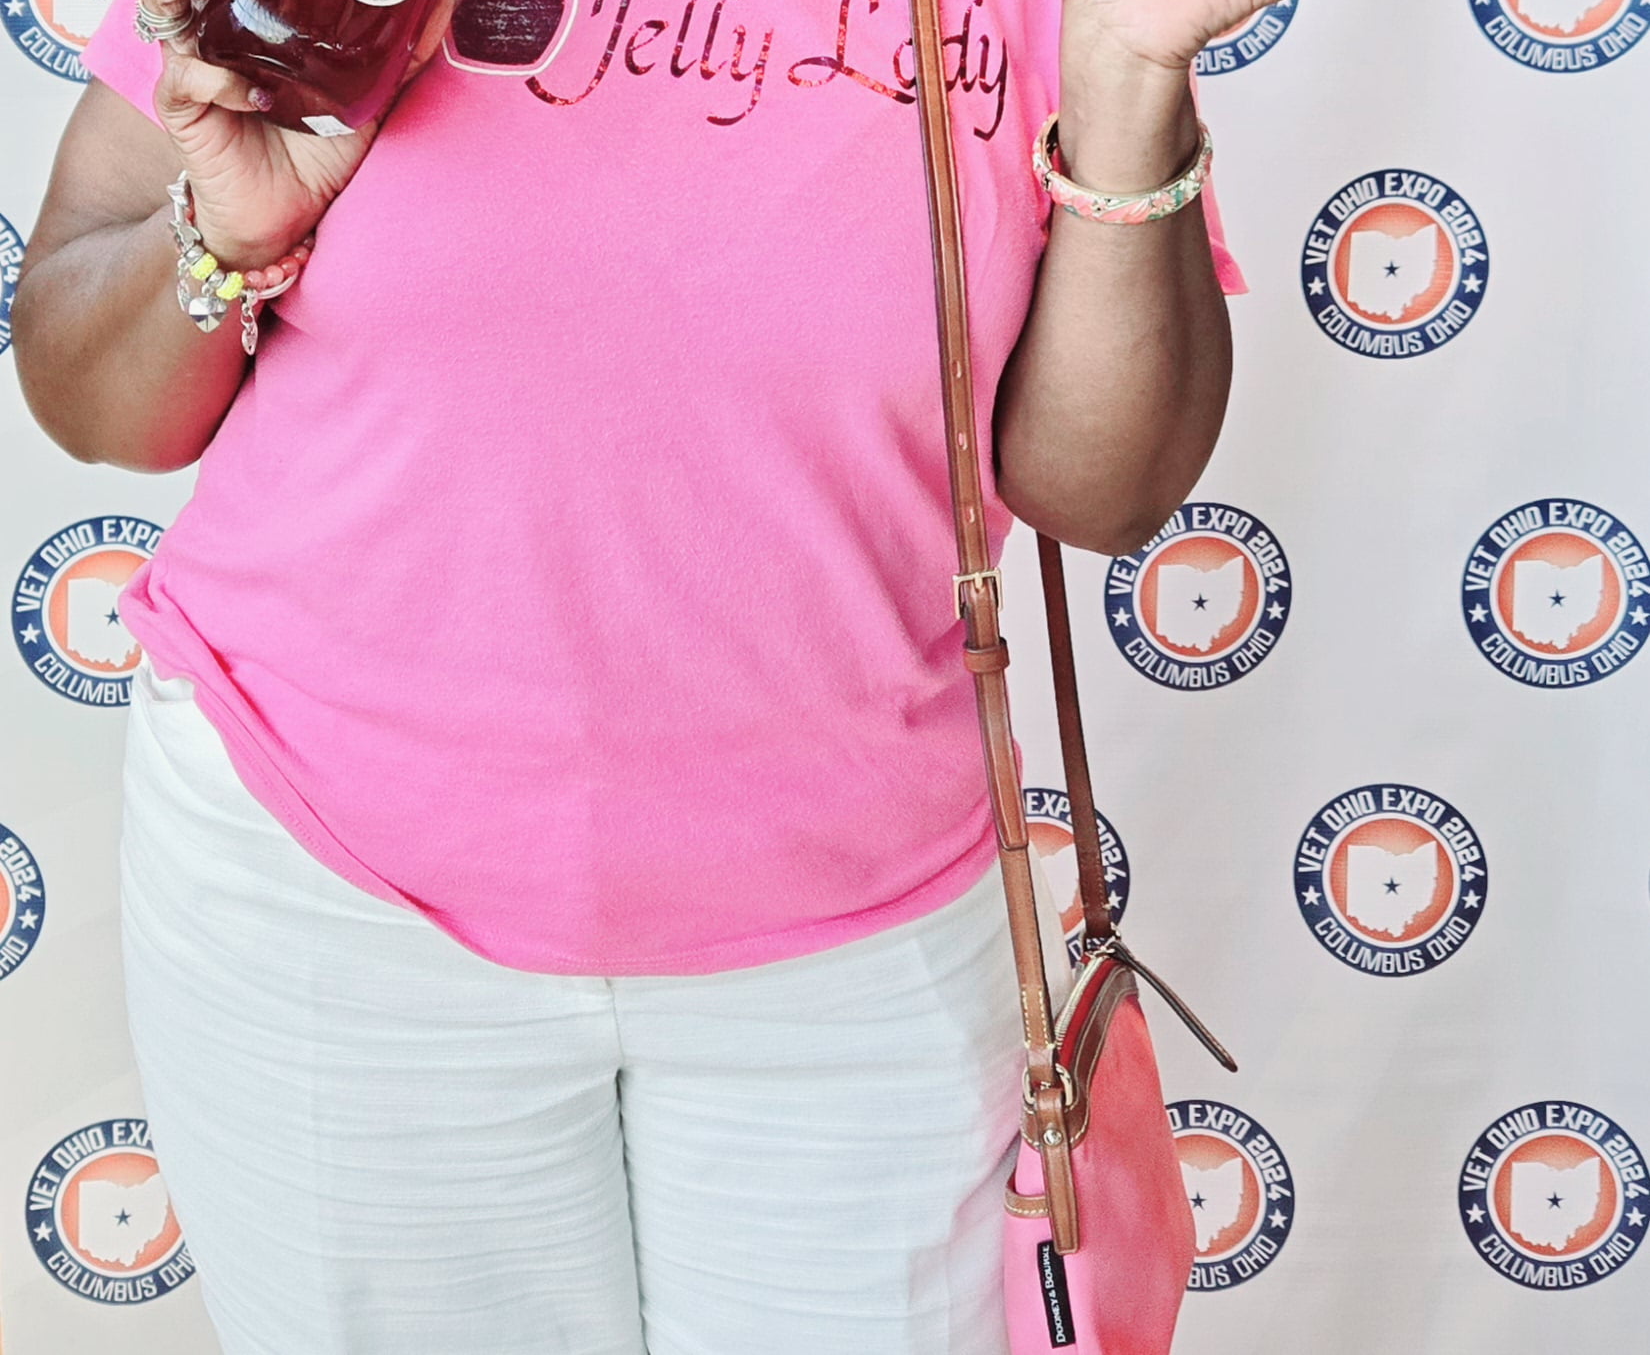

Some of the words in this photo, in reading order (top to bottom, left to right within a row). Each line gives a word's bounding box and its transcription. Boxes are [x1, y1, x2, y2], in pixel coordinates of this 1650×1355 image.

[19, 26, 92, 81] COLUM
[1237, 15, 1284, 60] OHIO
[1484, 15, 1598, 69] COLUMBUS
[1599, 14, 1649, 58] OHIO
[1305, 219, 1336, 265] VET
[1328, 177, 1379, 221] OHIO
[1384, 173, 1447, 207] EXPO
[1440, 200, 1486, 266] 2024
[1318, 304, 1424, 355] COLUMBUS
[1425, 300, 1472, 344] OHIO
[16, 565, 49, 613] VET
[40, 524, 96, 568] OHIO
[1108, 555, 1140, 595] VET
[1192, 507, 1252, 539] EXPO
[1247, 531, 1289, 593] 2024
[1466, 546, 1498, 592] VET
[1490, 506, 1543, 549] OHIO
[1548, 502, 1613, 538] EXPO
[1606, 531, 1650, 597] 2024
[34, 652, 132, 705] COLUMBU
[1125, 637, 1231, 688] COLUMBUS
[1232, 628, 1276, 672] OHIO
[1480, 632, 1591, 685] COLUMBUS
[1592, 631, 1640, 675] OHIO
[1026, 793, 1072, 824] EXP
[1300, 830, 1331, 876] VET
[1323, 790, 1375, 833] OHIO
[1380, 786, 1445, 822] EXPO
[1438, 816, 1487, 883] 2024
[0, 837, 42, 903] 2024
[1314, 917, 1425, 971] COLUMBUS
[1426, 918, 1474, 962] OHIO
[29, 1165, 61, 1211] VET
[52, 1127, 106, 1170] OHIO
[1189, 1104, 1252, 1140] EXPO
[1245, 1134, 1292, 1201] 2024
[1464, 1147, 1496, 1193] VET
[1487, 1108, 1540, 1150] OHIO
[1545, 1104, 1610, 1140] EXPO
[1603, 1134, 1650, 1200] 2024
[47, 1251, 158, 1302] COLUMBUS
[1232, 1235, 1279, 1278] OHIO
[1478, 1233, 1588, 1286] COLUMBUS
[1589, 1233, 1637, 1276] OHIO
